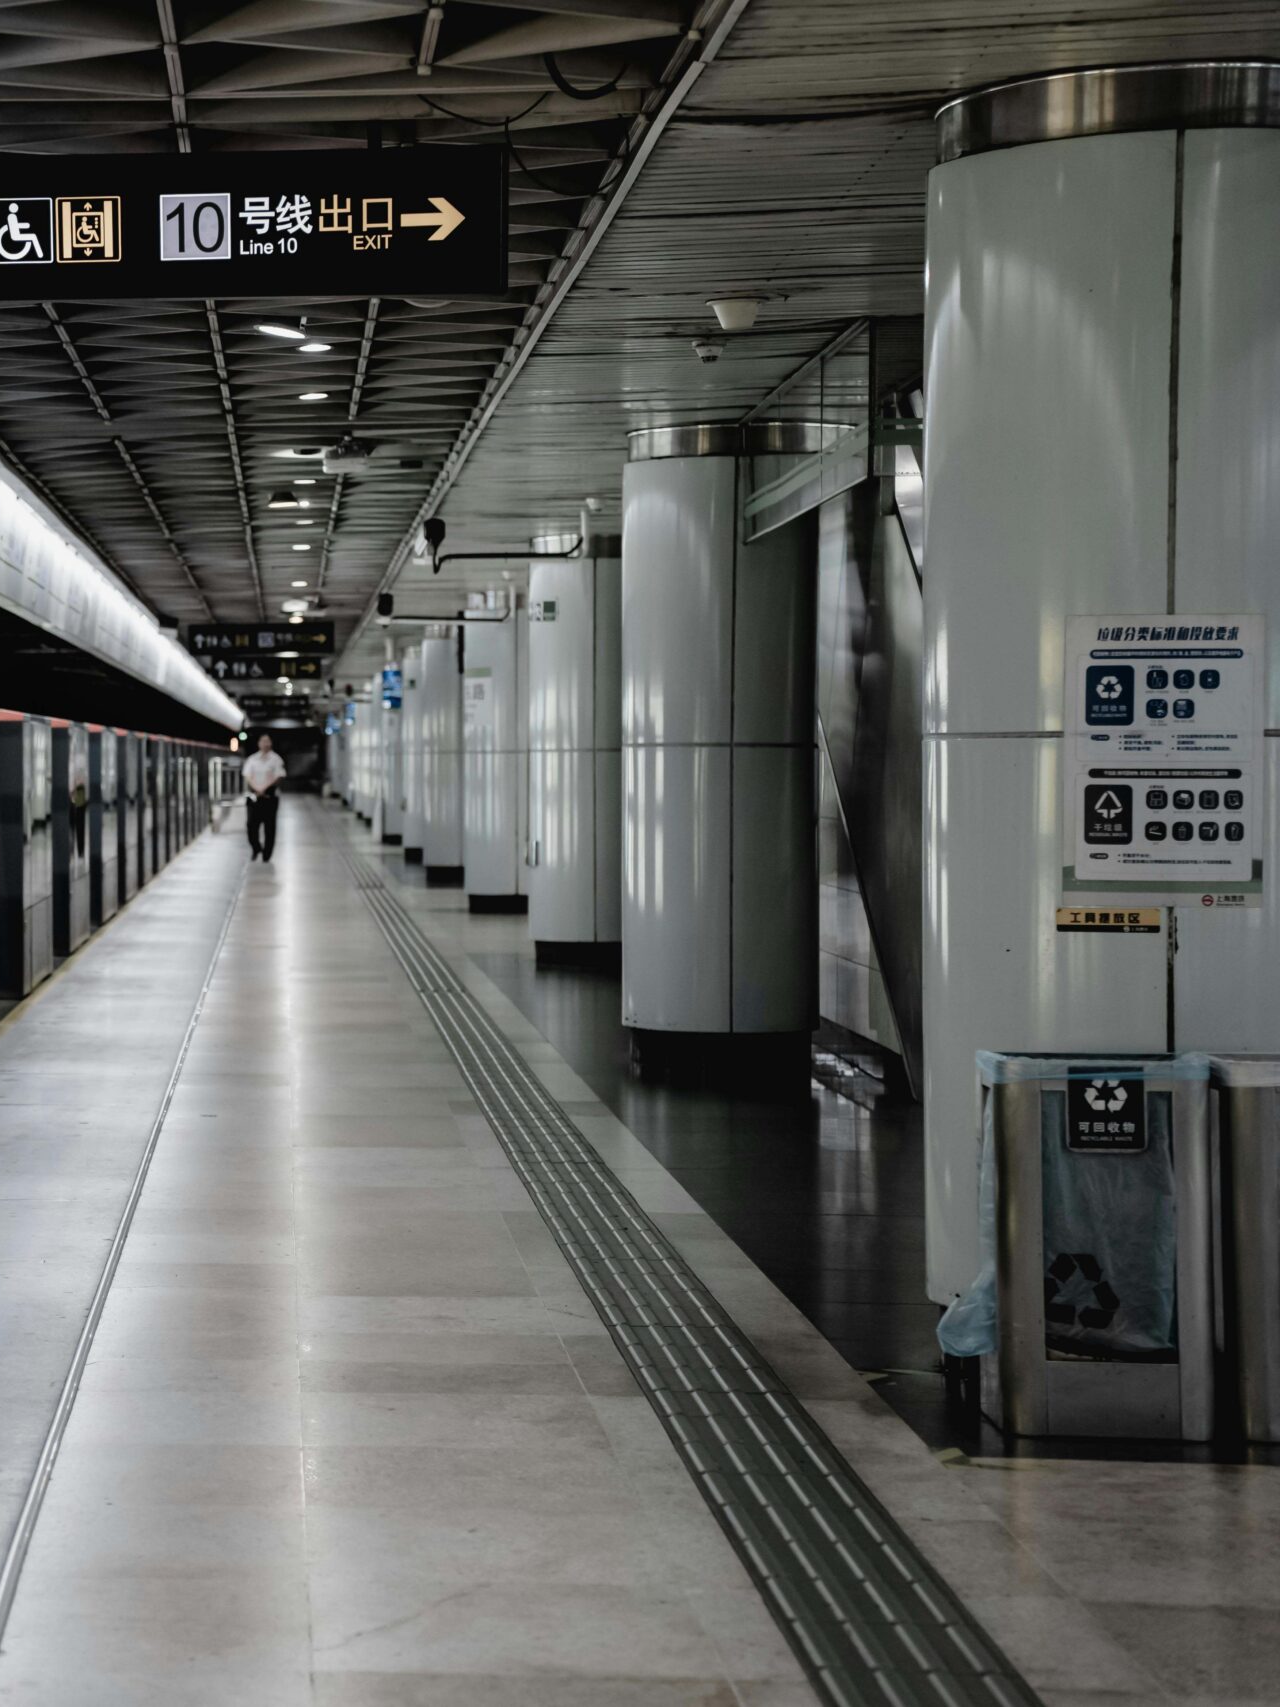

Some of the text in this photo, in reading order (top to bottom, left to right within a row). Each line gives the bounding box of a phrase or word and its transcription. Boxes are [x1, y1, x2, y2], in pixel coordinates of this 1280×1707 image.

[165, 194, 393, 253] 10 号线 出口
[239, 237, 298, 256] Line 10
[353, 234, 392, 250] EXIT
[1096, 625, 1240, 642] 垃圾分类标准和投放要求
[1078, 1121, 1136, 1134] 可回收物
